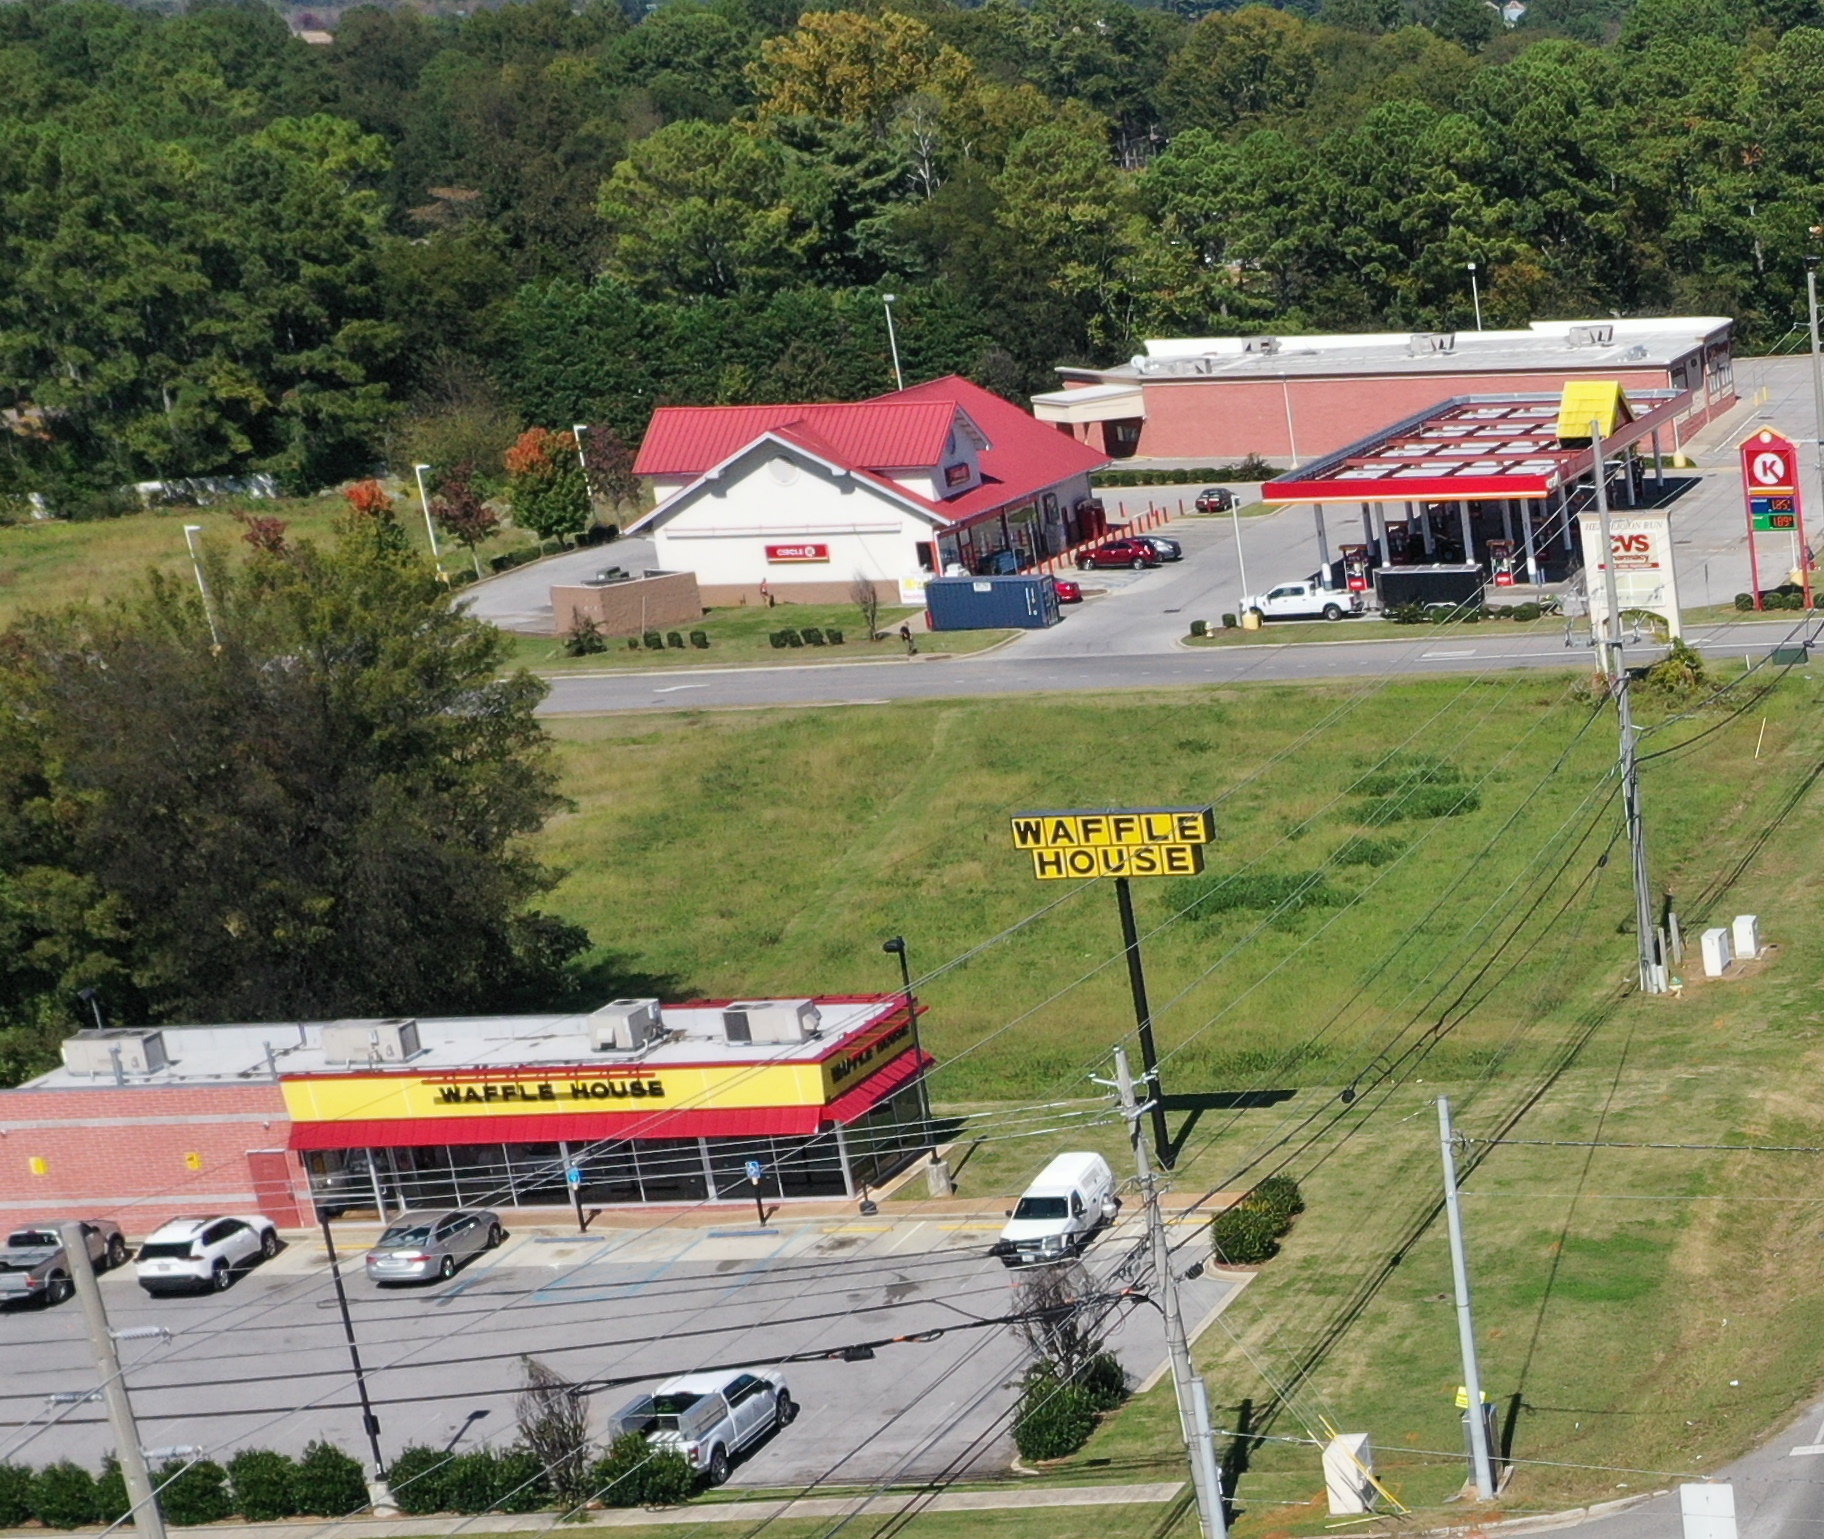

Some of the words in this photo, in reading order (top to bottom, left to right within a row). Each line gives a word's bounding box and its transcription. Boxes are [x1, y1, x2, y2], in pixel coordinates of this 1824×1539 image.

[776, 548, 803, 557] CIRCLE
[1014, 815, 1201, 848] WAFFLE
[1037, 846, 1190, 875] HOUSE
[438, 1083, 556, 1104] WAFFLE
[570, 1079, 666, 1100] HOUSE
